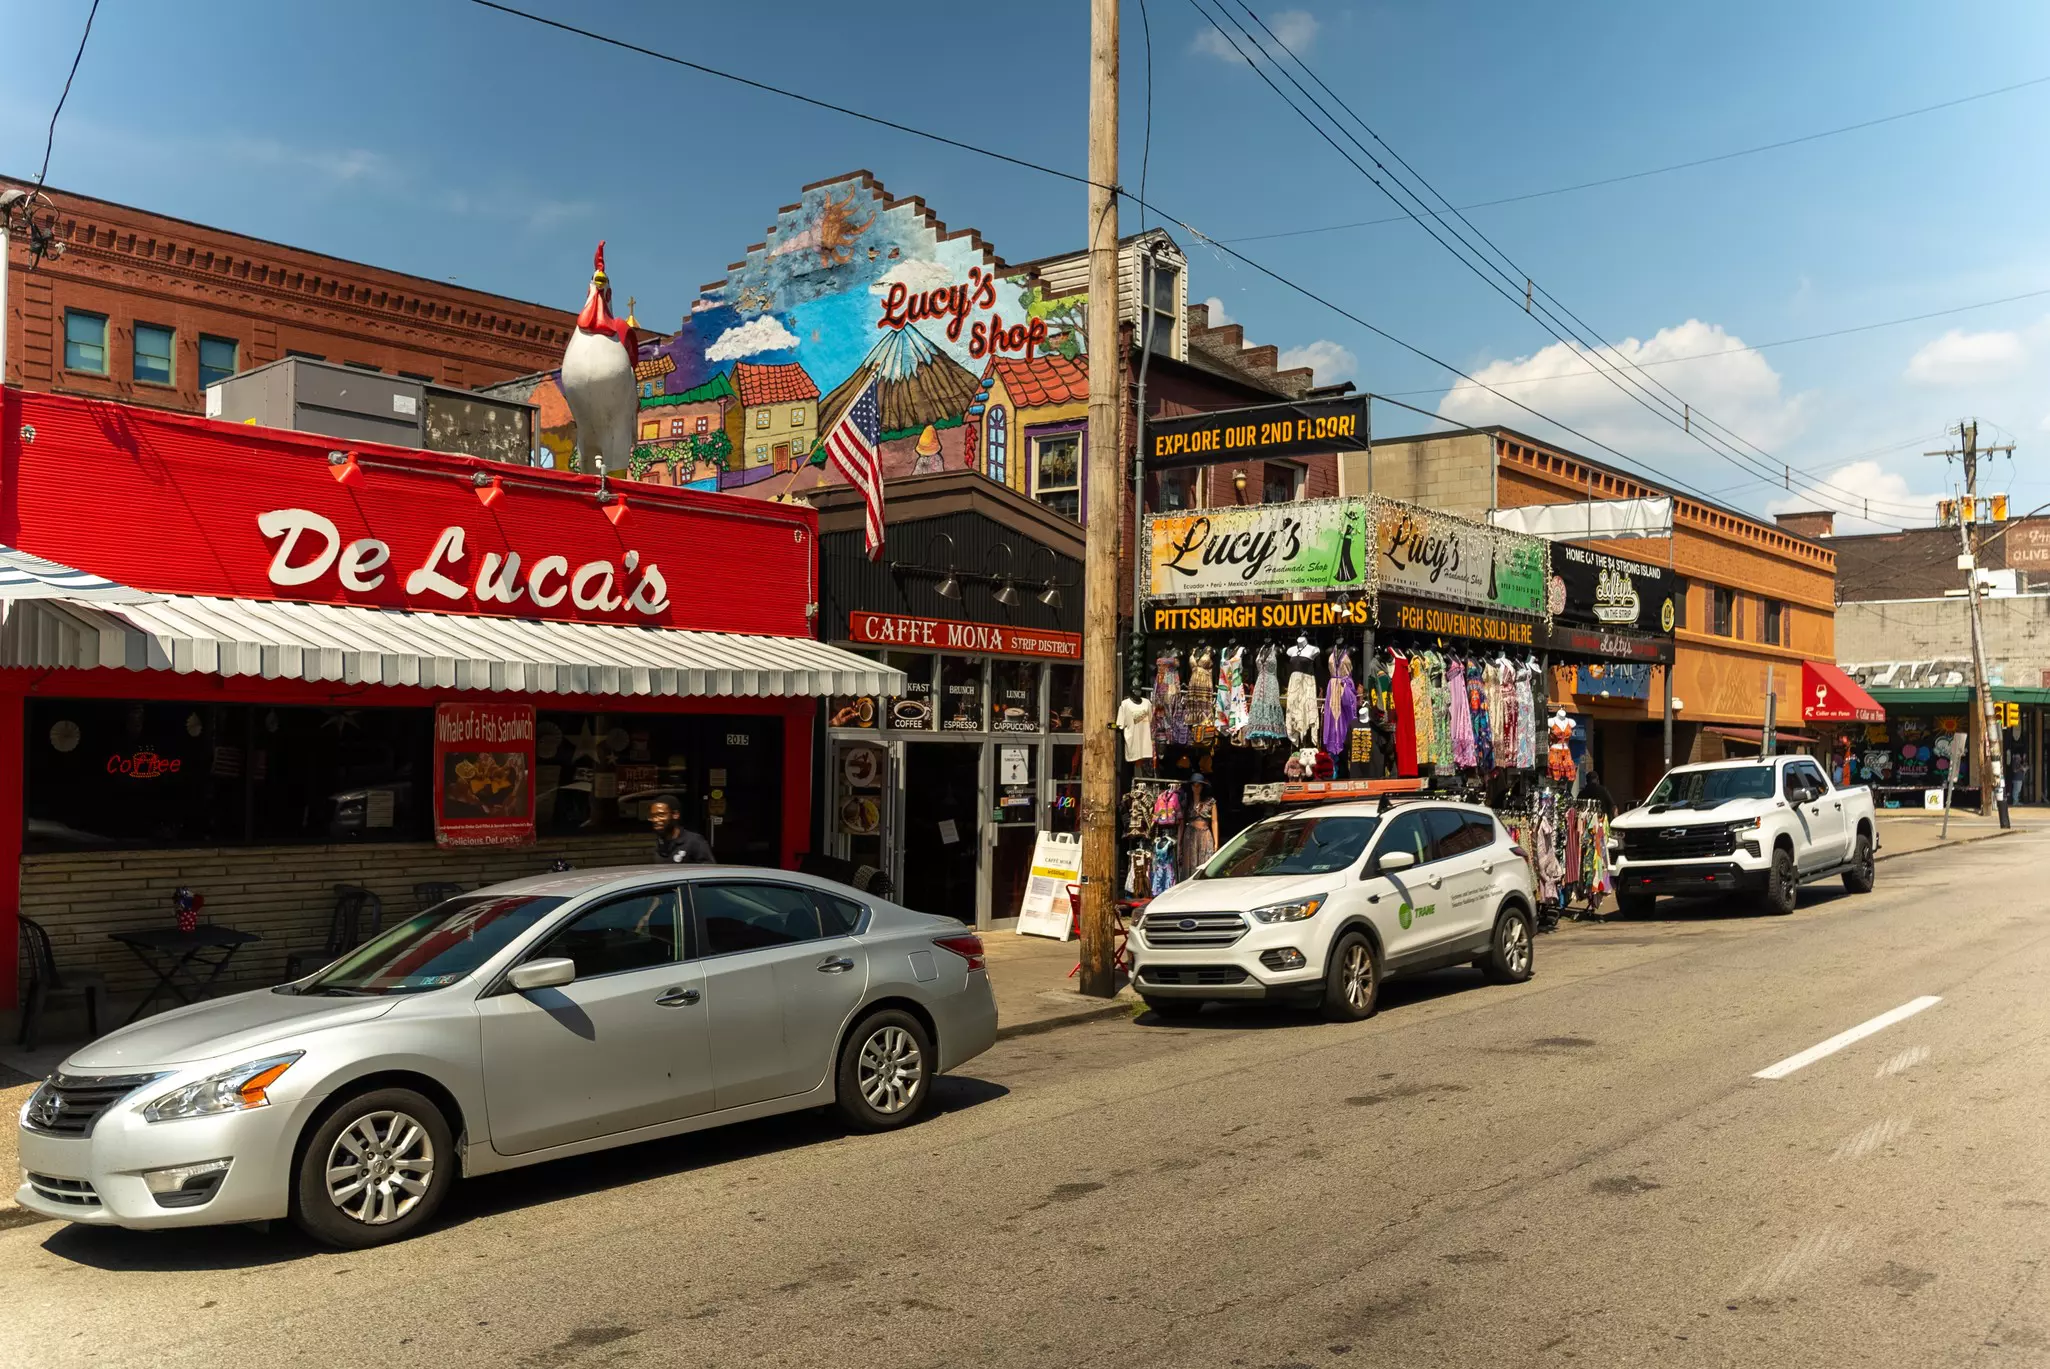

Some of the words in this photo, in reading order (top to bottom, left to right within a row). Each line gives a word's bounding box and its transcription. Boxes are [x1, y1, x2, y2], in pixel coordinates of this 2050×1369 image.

[877, 266, 996, 343] Lucy's
[1156, 428, 1221, 457] EXPLORE
[1225, 425, 1256, 449] OUR
[1261, 421, 1292, 445] 2ND
[1298, 415, 1355, 441] FLOOR!
[1161, 517, 1301, 580] Lucy's
[1382, 514, 1459, 583] Lucy's
[2013, 549, 2049, 560] OLIVE
[257, 508, 390, 592] De
[404, 526, 670, 615] Luca's
[1264, 563, 1305, 574] Handmade
[1307, 562, 1328, 573] Shop
[1565, 547, 1585, 563] HOME
[1595, 554, 1608, 568] THE
[1616, 560, 1640, 575] STRONG
[1640, 564, 1661, 579] ISLAND
[1253, 578, 1285, 586] Guatemala
[1470, 574, 1483, 586] Shop
[1155, 606, 1256, 630] PITTSBURGH
[1402, 606, 1424, 630] PGH
[1426, 608, 1482, 638] SOUVENIRS
[1483, 617, 1507, 641] SOLD
[948, 623, 1002, 650] MONA
[1011, 637, 1036, 651] STRIP
[1038, 638, 1076, 655] DISTRICT
[949, 685, 975, 695] BRUNCH
[1006, 690, 1026, 699] LUNCH
[438, 712, 464, 742] Whale
[465, 710, 474, 740] of
[474, 718, 480, 739] a
[481, 713, 497, 743] Fish
[498, 712, 533, 743] Sandwich
[894, 720, 923, 728] COFFEE
[944, 720, 978, 729] ESPRESSO
[993, 722, 1035, 731] CAPPUCCINO
[727, 734, 749, 745] 2015
[106, 753, 182, 775] Coffee
[1414, 903, 1436, 918] TRANE
